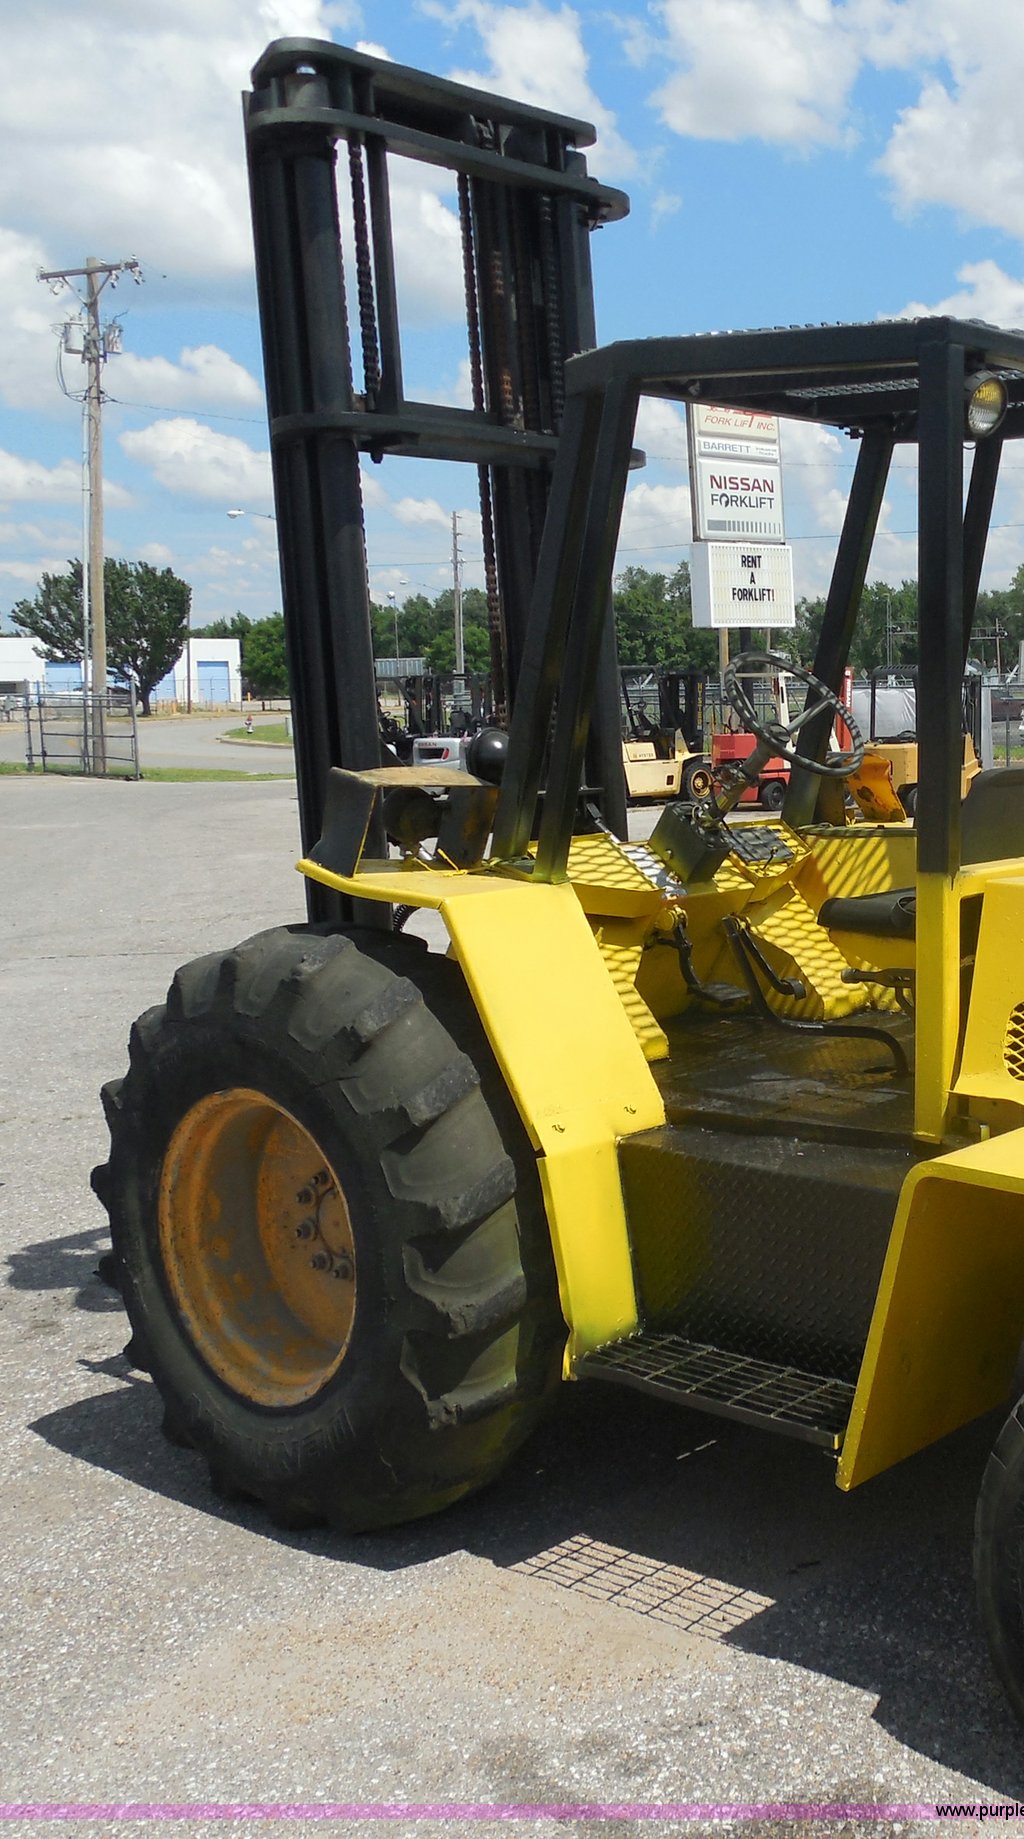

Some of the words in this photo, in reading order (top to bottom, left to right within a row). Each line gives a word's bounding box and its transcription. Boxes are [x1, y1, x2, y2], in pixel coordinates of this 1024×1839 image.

[704, 415, 731, 426] FORK
[734, 411, 755, 428] LIFT
[756, 423, 775, 431] INC.
[703, 441, 751, 453] BARRETT
[710, 474, 774, 493] NISSAN
[711, 493, 774, 509] FORKLIFT
[741, 555, 762, 568] RENT
[749, 571, 756, 585] A
[732, 588, 775, 602] FORKLIFT!
